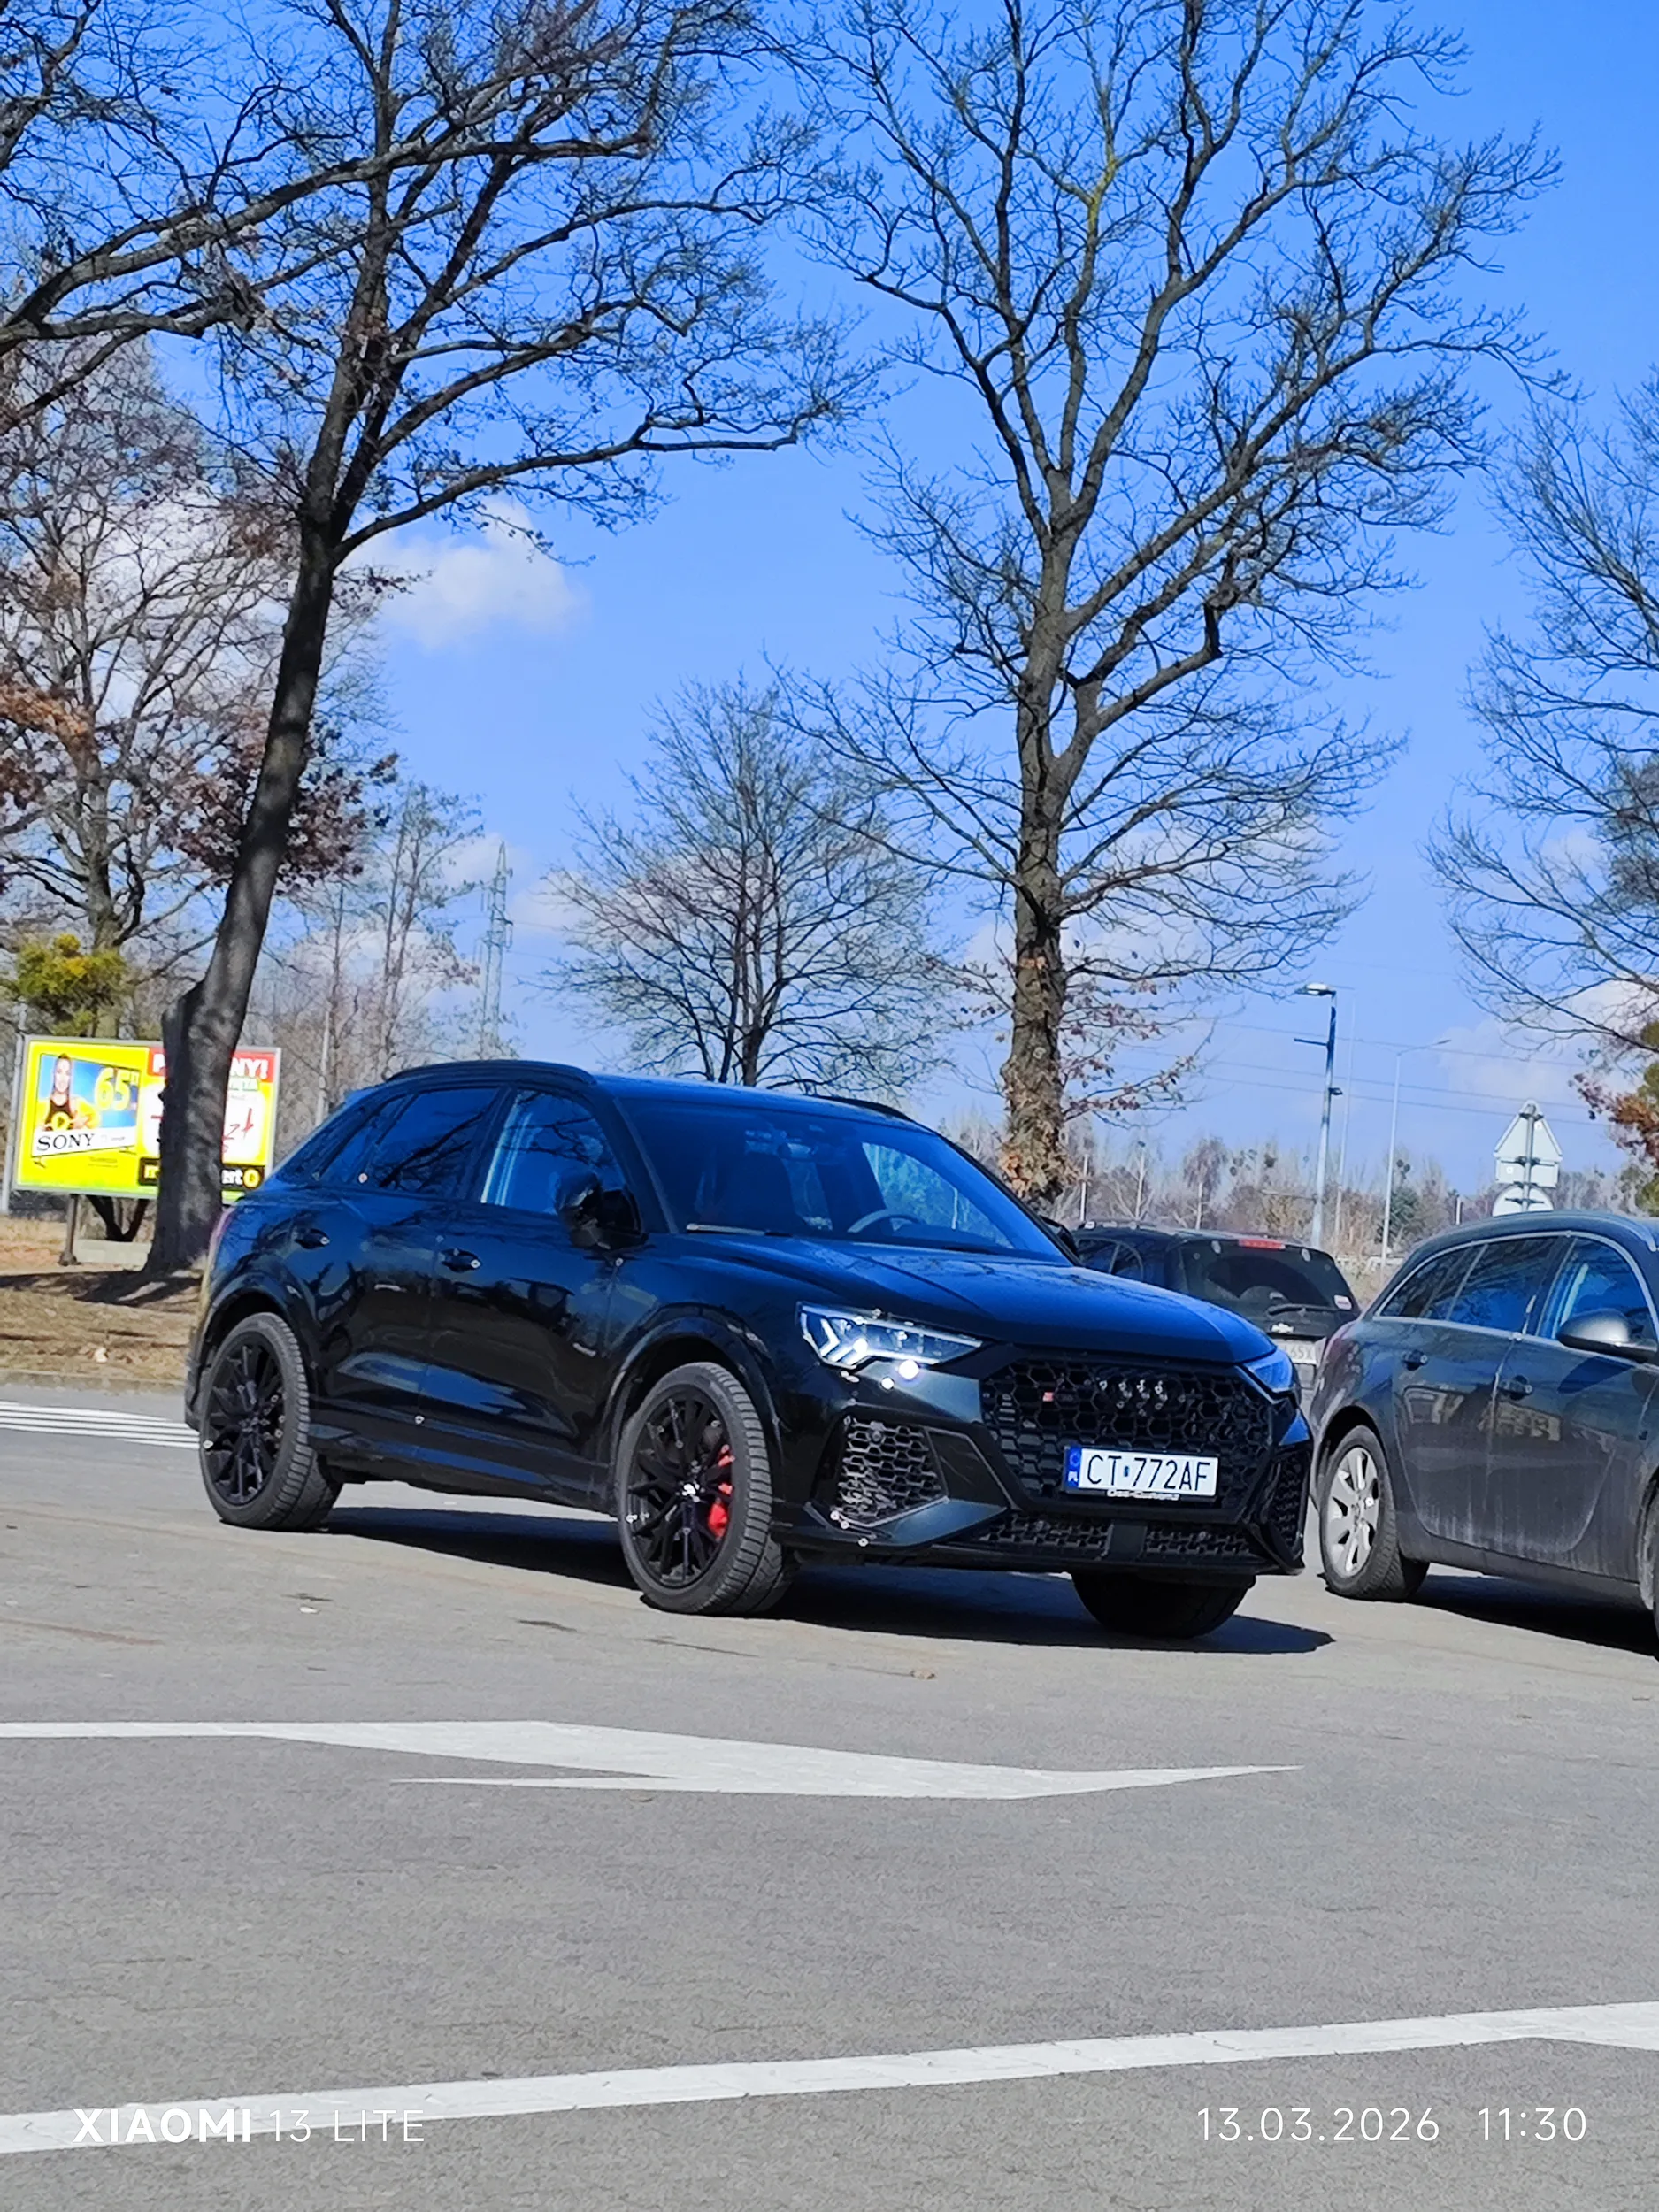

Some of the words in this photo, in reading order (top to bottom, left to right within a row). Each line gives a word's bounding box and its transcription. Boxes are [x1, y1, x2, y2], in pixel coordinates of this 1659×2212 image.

[36, 1133, 95, 1152] SONY
[1087, 1454, 1122, 1486] CT
[1132, 1456, 1210, 1492] 772AF
